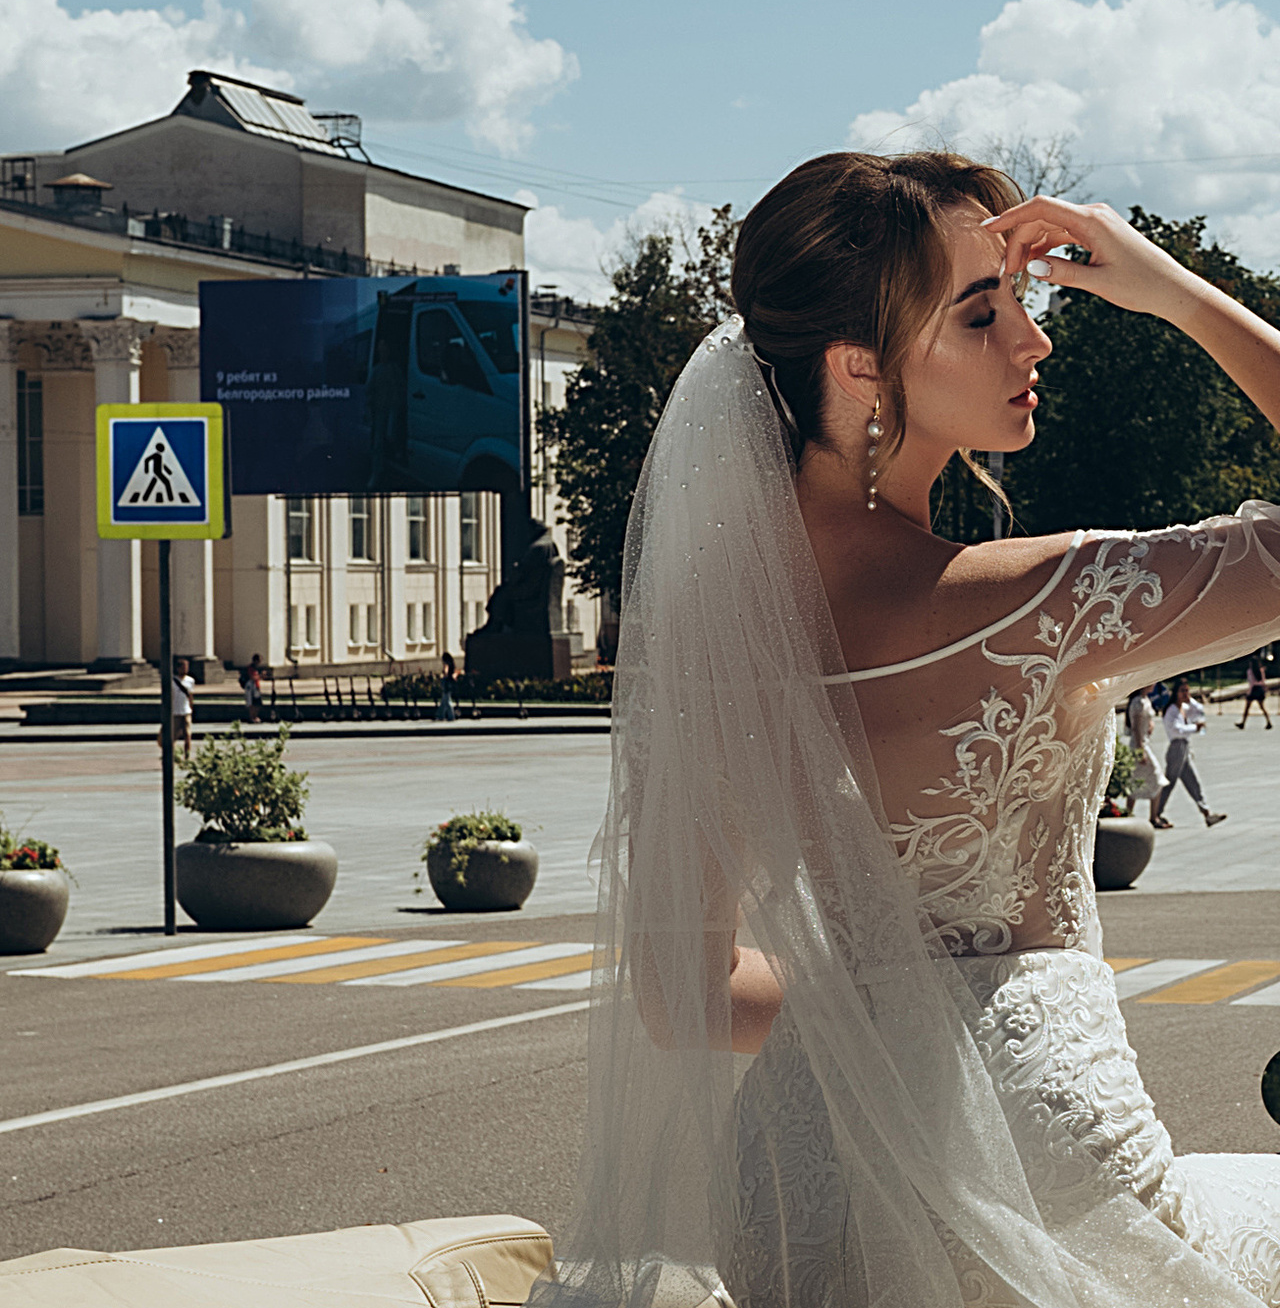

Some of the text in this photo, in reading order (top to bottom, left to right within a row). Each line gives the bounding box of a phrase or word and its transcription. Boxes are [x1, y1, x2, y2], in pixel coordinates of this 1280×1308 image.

[216, 369, 278, 387] 9 ребят из
[216, 384, 351, 402] Белгородского района
